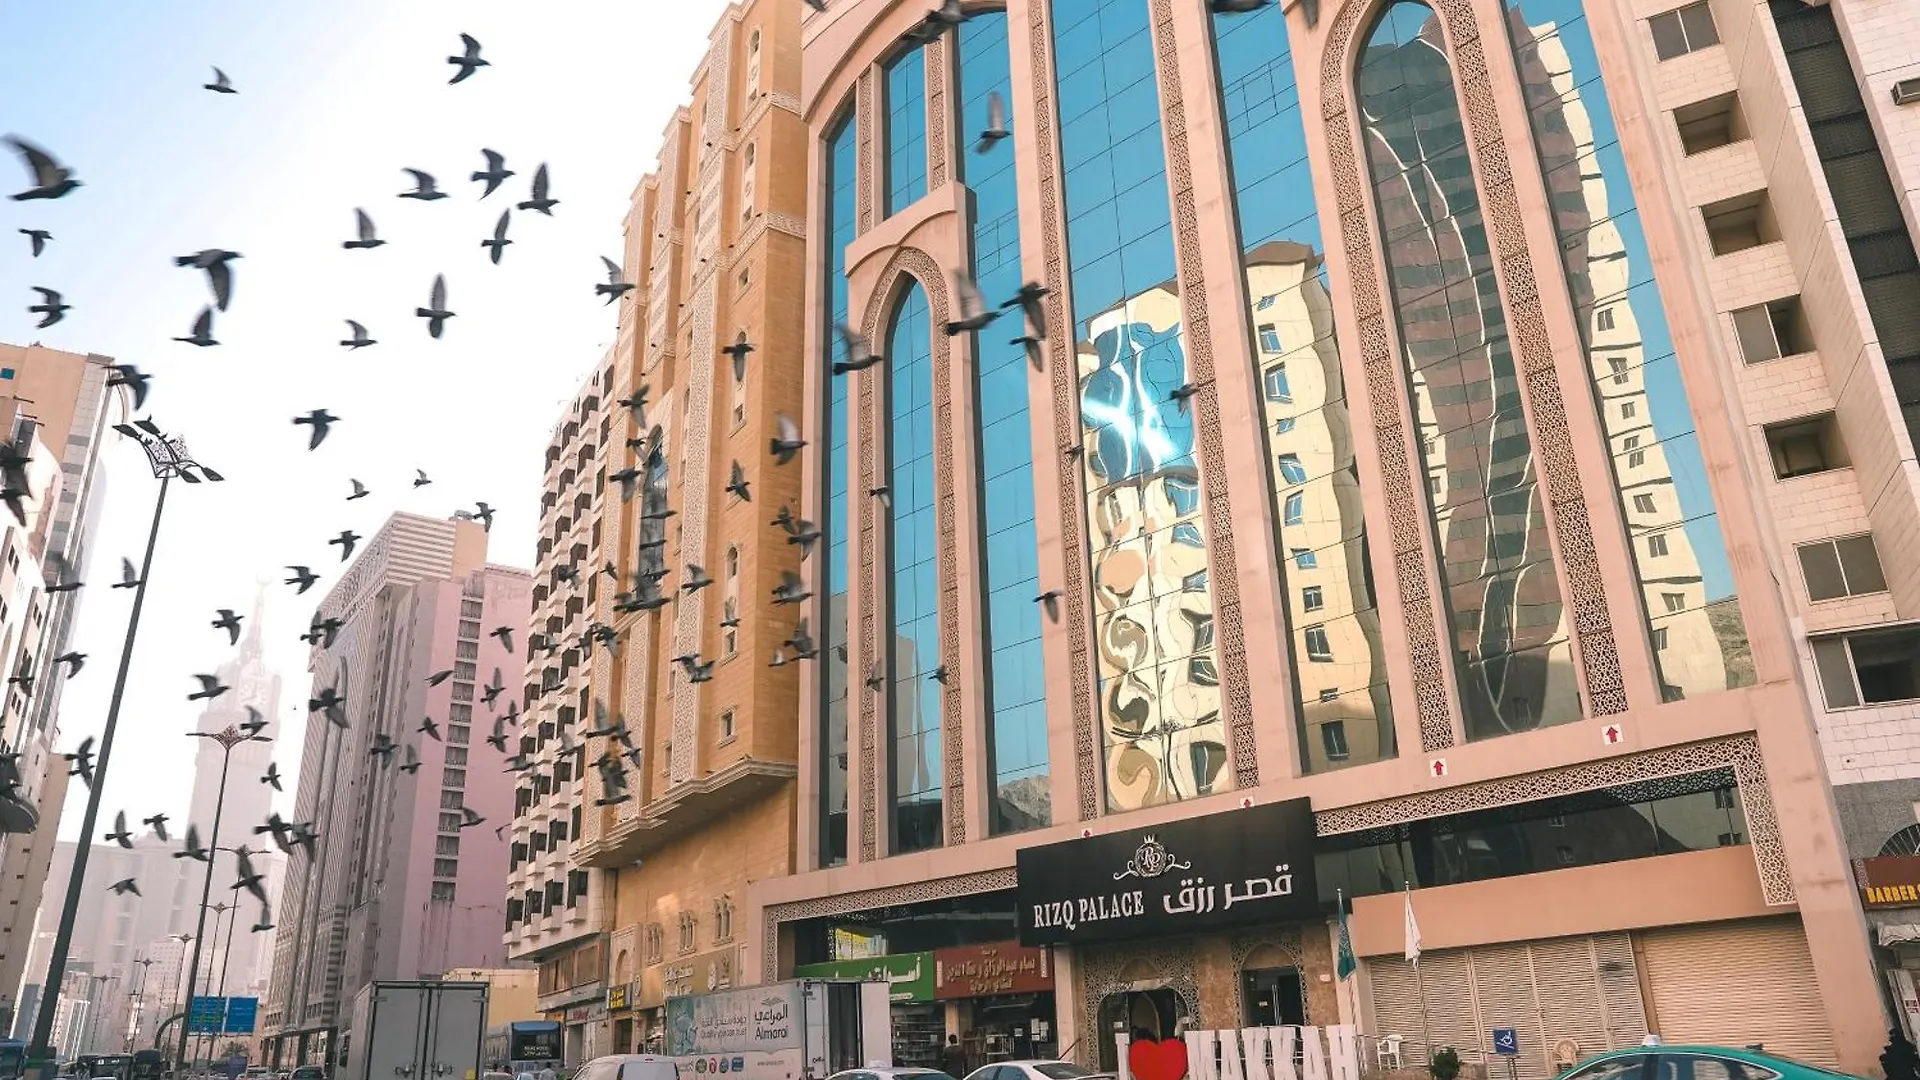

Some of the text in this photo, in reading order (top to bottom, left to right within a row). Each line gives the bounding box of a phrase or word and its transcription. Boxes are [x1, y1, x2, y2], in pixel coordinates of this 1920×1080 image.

[1163, 863, 1294, 914] قصر رزق
[1866, 885, 1918, 904] BARBER
[1033, 889, 1145, 931] RIZQ PALACE
[754, 1003, 788, 1026] المراعي
[754, 1026, 789, 1040] Almarai
[1115, 1025, 1363, 1080] I MAKKAH
